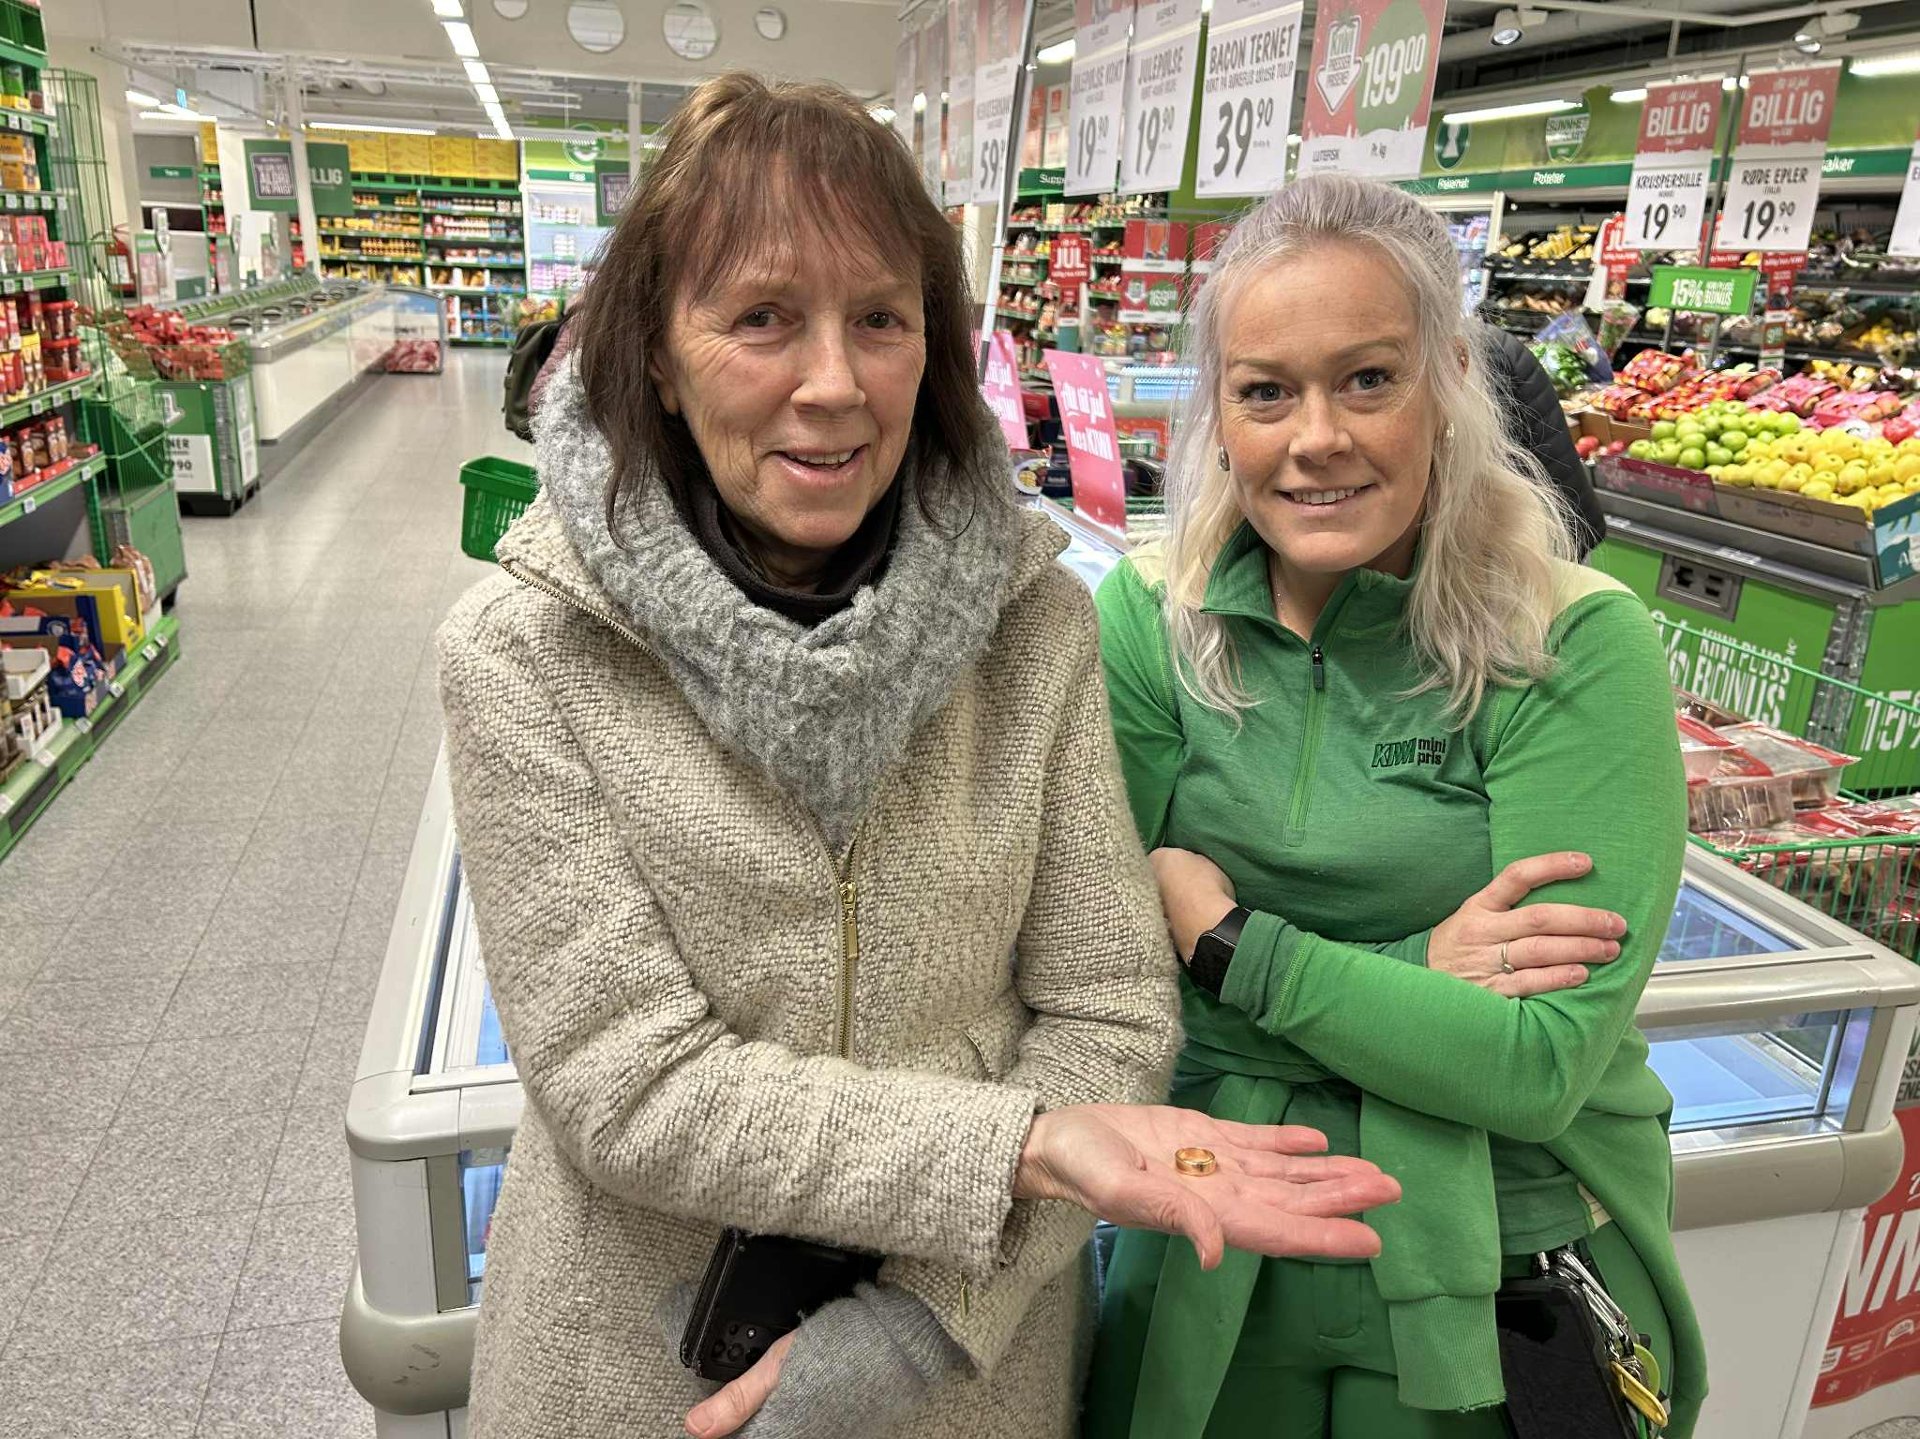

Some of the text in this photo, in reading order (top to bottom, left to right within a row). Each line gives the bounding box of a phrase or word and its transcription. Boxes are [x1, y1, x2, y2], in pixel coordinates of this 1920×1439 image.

[1209, 24, 1295, 74] BACON TERNET
[1646, 102, 1711, 137] BILLIG
[1749, 90, 1825, 127] BILLIG
[1635, 173, 1702, 190] KRUSPERSILLE
[1741, 167, 1809, 186] RØDE EPLER
[1054, 248, 1086, 269] JUL
[1671, 279, 1703, 307] 15%
[1089, 389, 1107, 424] jul
[1692, 652, 1786, 729] BONUS
[1861, 691, 1920, 751] 15
[1371, 737, 1417, 767] KIWI
[1417, 751, 1442, 766] pris
[1418, 737, 1446, 753] mini
